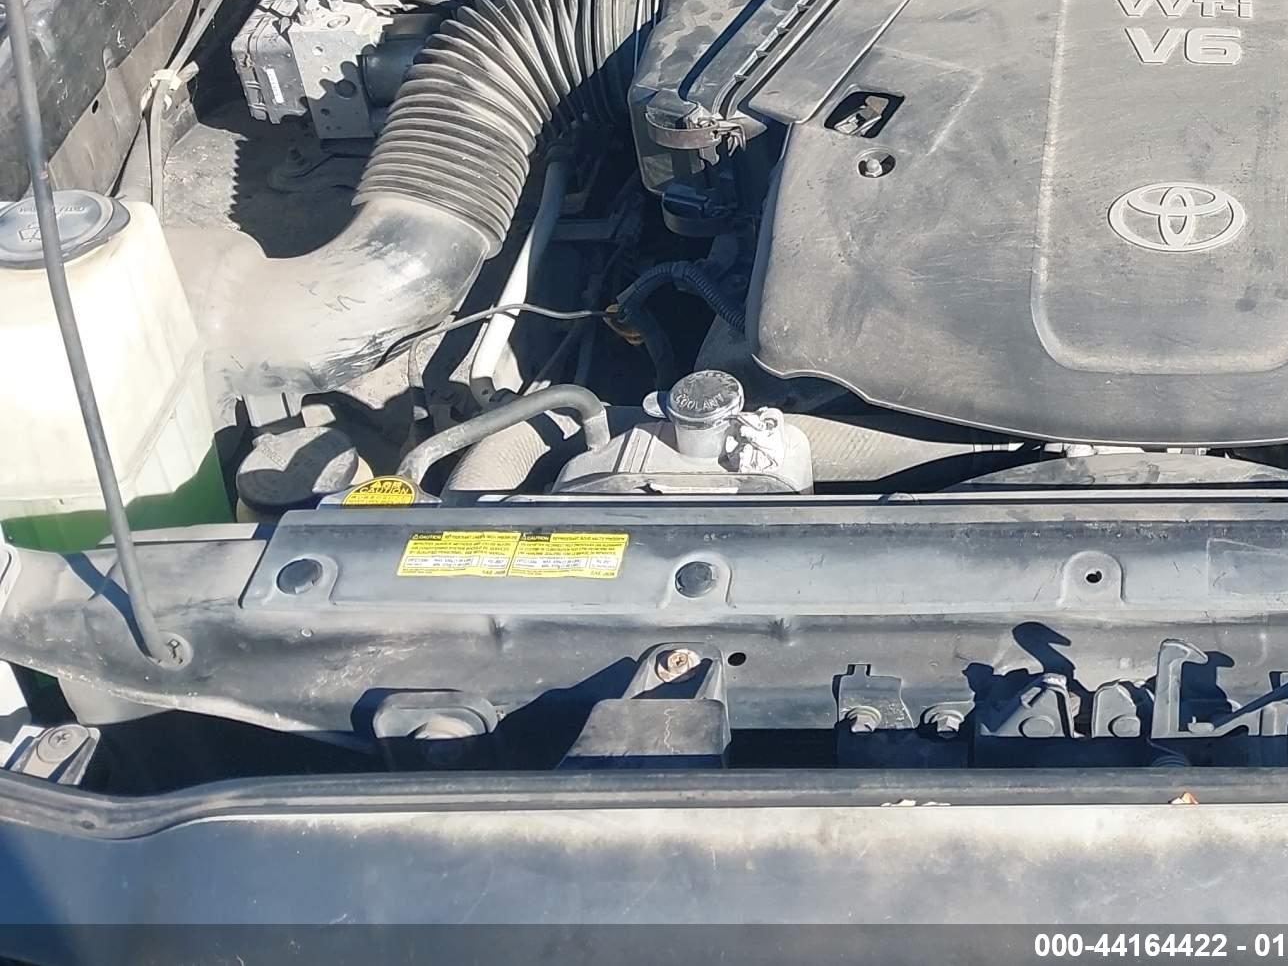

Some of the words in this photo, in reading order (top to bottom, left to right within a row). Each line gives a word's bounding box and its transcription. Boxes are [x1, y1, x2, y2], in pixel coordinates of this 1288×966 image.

[1124, 27, 1243, 65] V6
[675, 392, 725, 411] COOLANT
[359, 486, 410, 494] CAUTION
